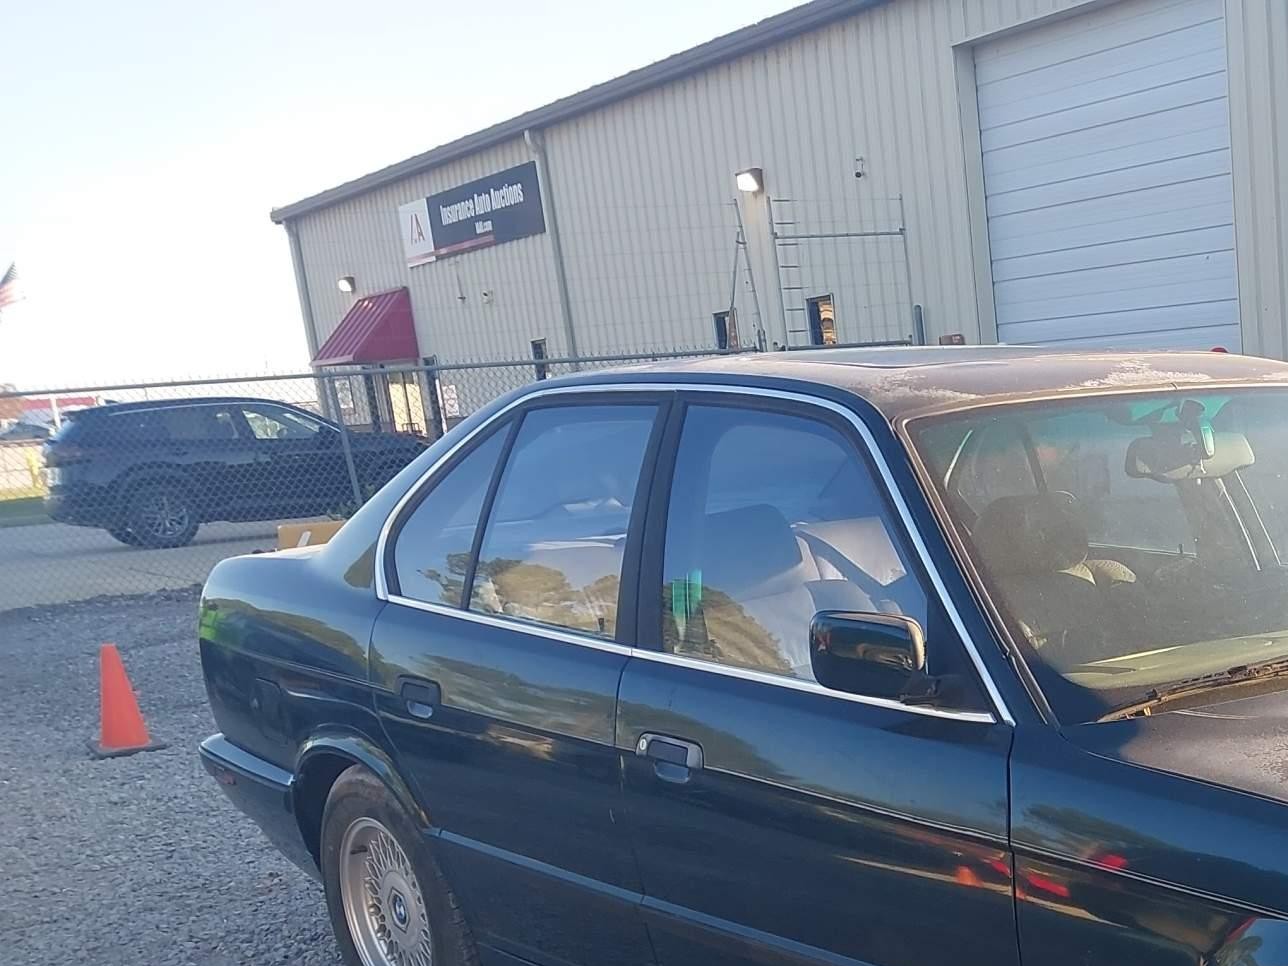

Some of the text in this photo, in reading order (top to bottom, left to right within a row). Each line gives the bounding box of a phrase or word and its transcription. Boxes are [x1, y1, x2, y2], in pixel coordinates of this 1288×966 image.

[440, 182, 524, 226] Insurance Auto Auctions
